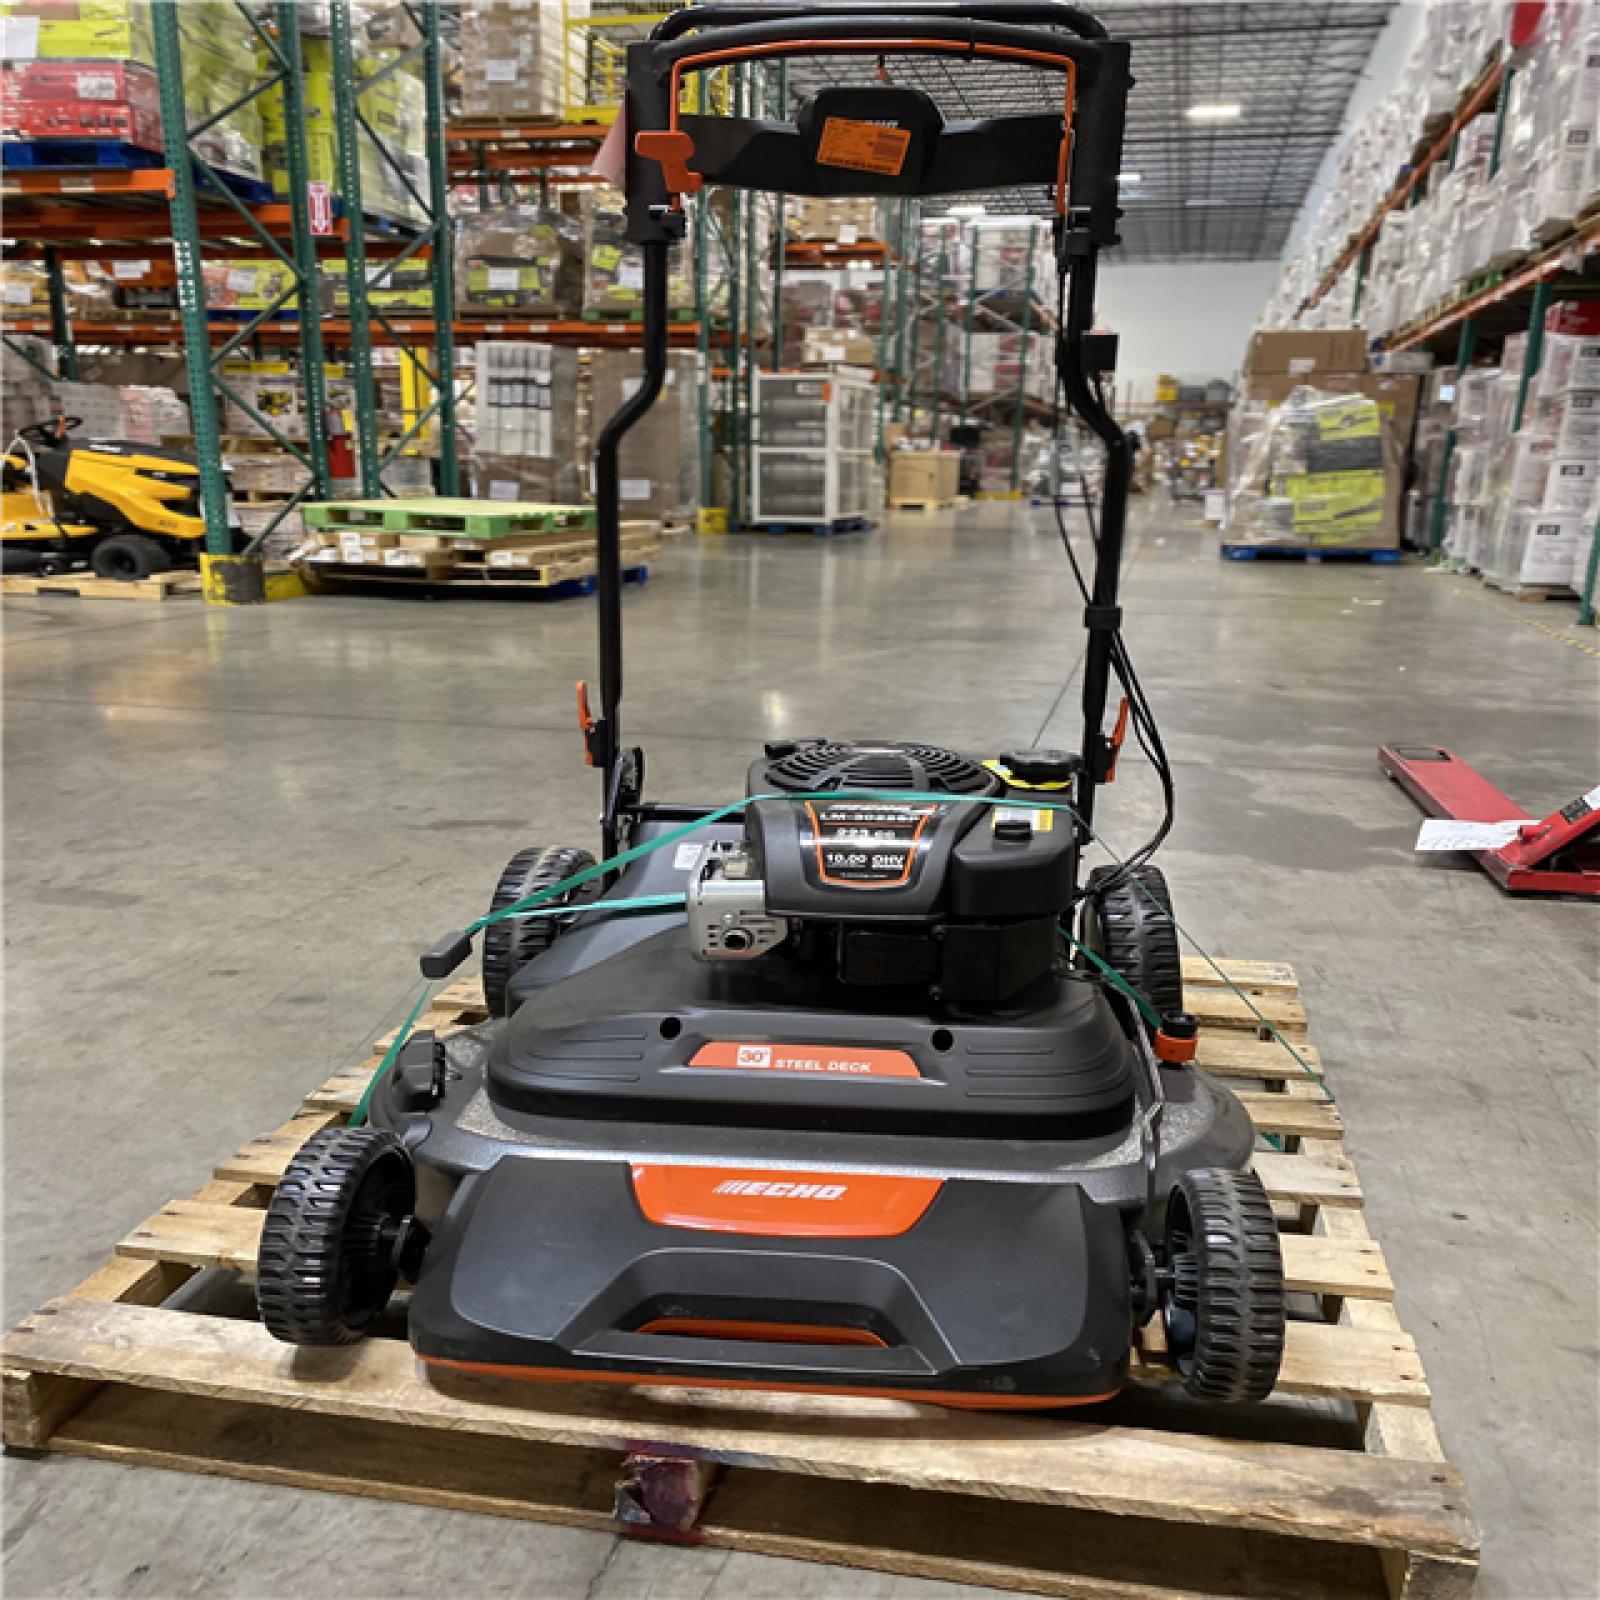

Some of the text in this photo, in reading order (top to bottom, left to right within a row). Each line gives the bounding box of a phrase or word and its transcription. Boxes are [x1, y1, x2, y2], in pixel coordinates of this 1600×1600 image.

[872, 854, 905, 867] OHV
[775, 1058, 822, 1071] STEEL
[826, 1060, 871, 1073] DECK
[736, 1181, 849, 1200] ECHO
